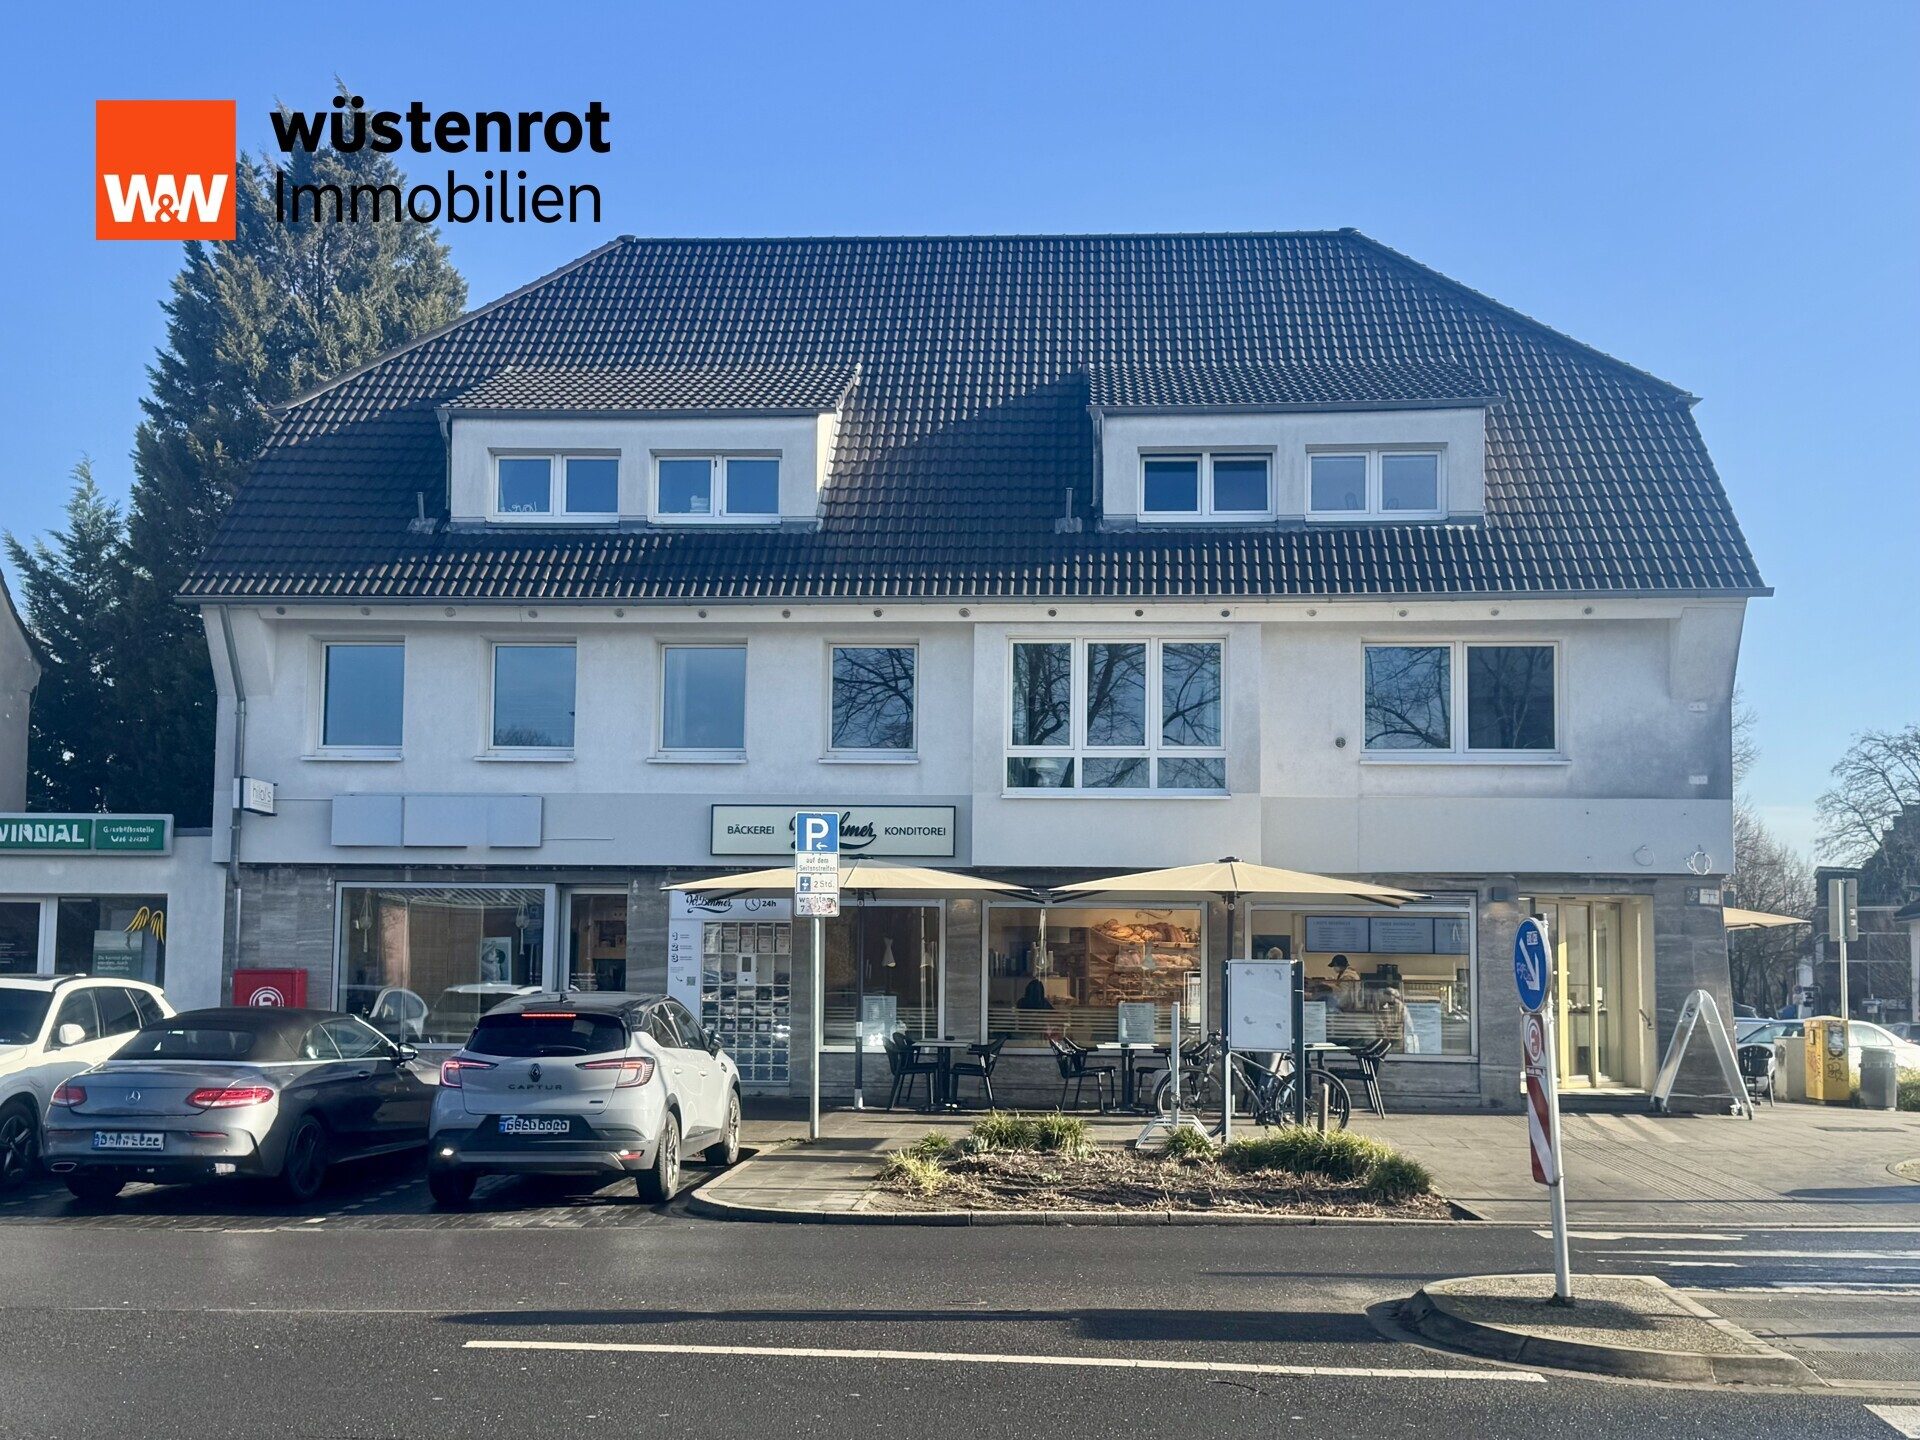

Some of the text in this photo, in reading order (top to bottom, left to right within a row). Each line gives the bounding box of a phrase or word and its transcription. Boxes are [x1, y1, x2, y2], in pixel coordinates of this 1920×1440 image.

[727, 824, 775, 835] BÄCKEREI
[884, 826, 946, 836] KONDITOREI
[806, 818, 829, 850] P
[820, 880, 835, 888] Std.
[671, 943, 679, 951] 2
[671, 954, 679, 963] 3
